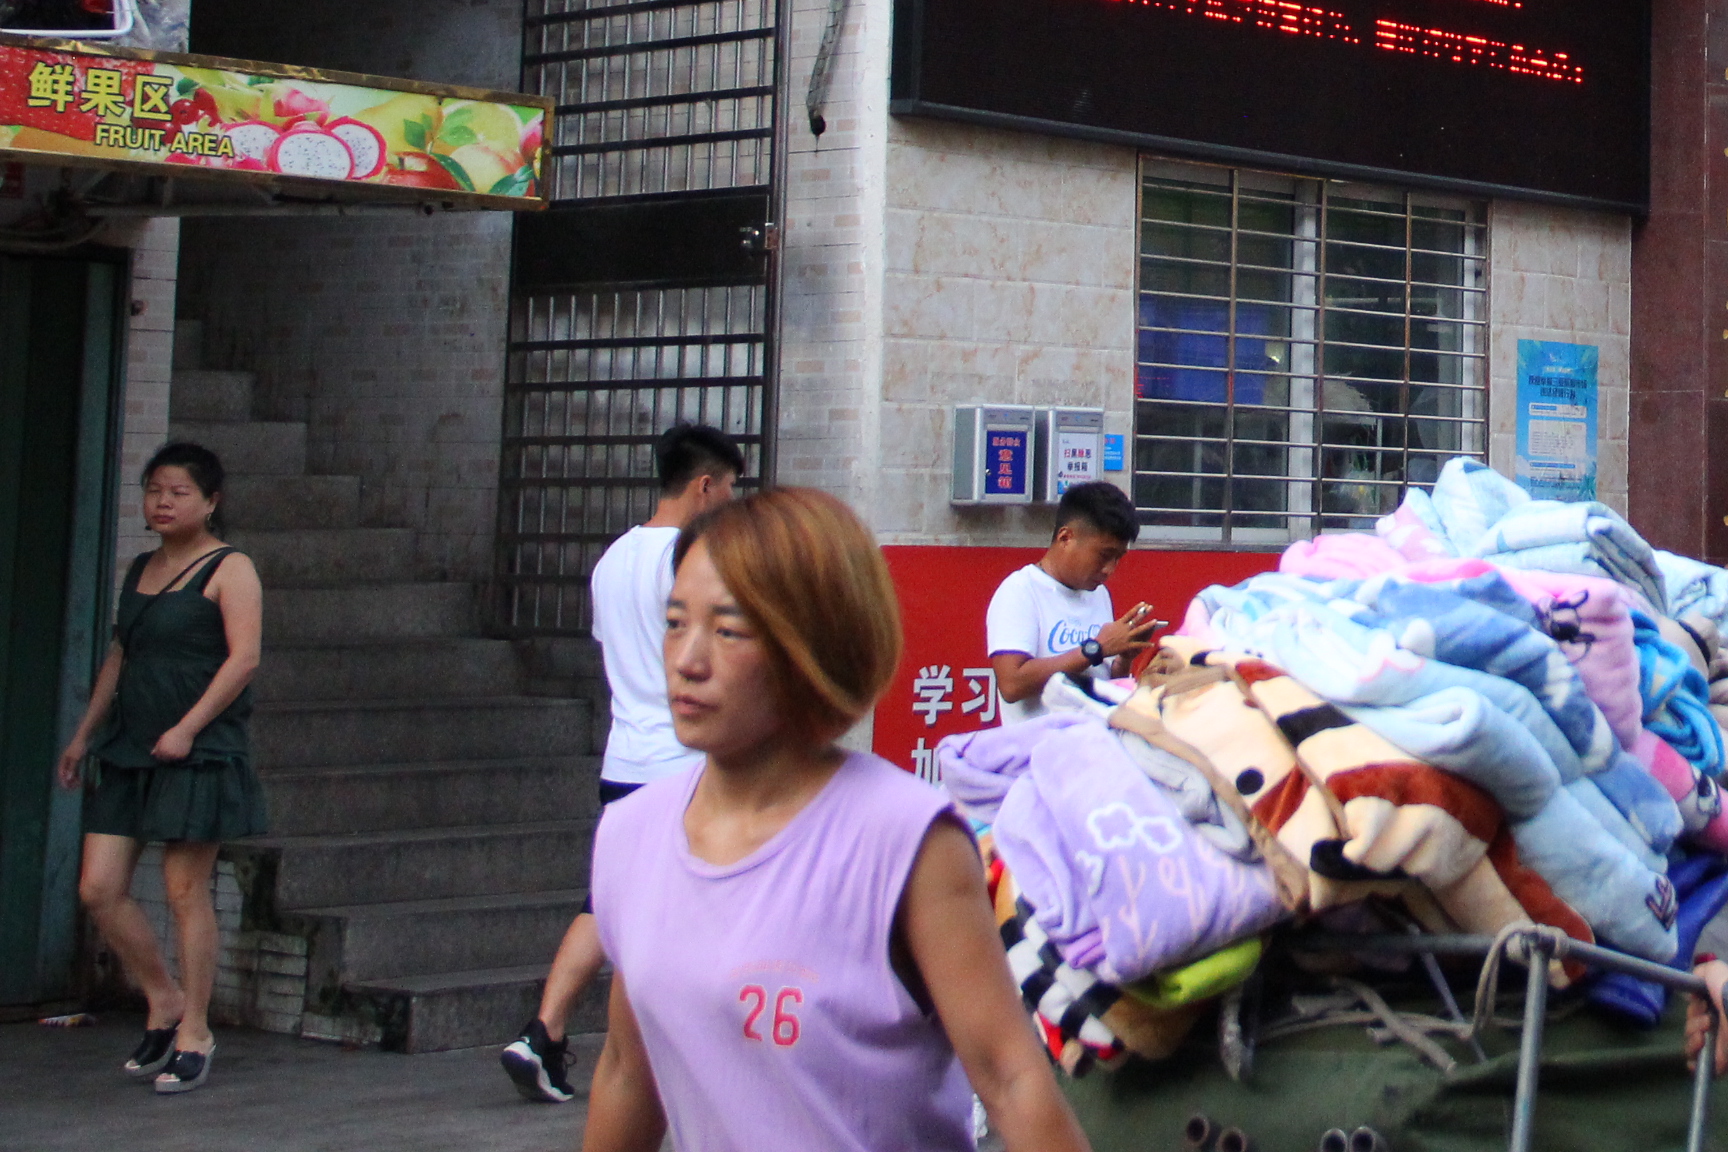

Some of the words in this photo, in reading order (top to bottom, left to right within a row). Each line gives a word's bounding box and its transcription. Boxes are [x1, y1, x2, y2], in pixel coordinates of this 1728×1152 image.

[27, 61, 174, 122] 鲜果区
[94, 123, 166, 152] FRUIT
[169, 130, 235, 158] AREA
[912, 664, 997, 726] 学习
[739, 983, 804, 1047] 26
